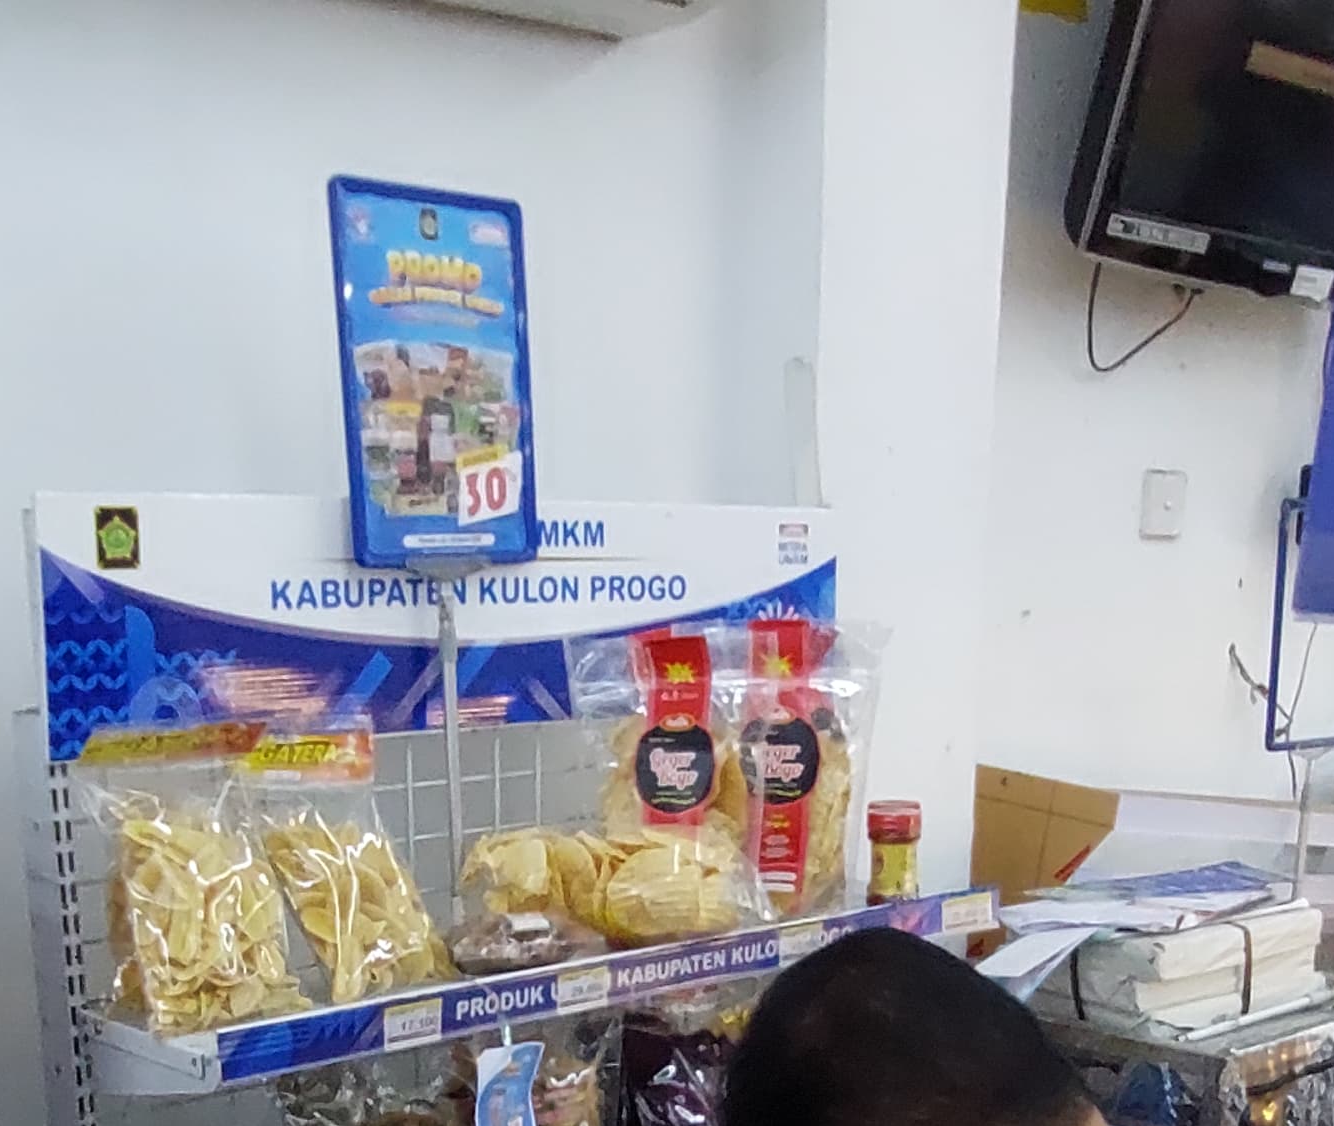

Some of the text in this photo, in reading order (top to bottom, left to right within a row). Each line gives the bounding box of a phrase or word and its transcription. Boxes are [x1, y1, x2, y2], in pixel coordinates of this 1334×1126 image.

[535, 520, 606, 549] MKM
[270, 574, 687, 611] KABUPATEN KULON PROGO
[454, 987, 545, 1022] PRODUK
[616, 948, 727, 989] KABUPATEN
[730, 939, 780, 967] KULO
